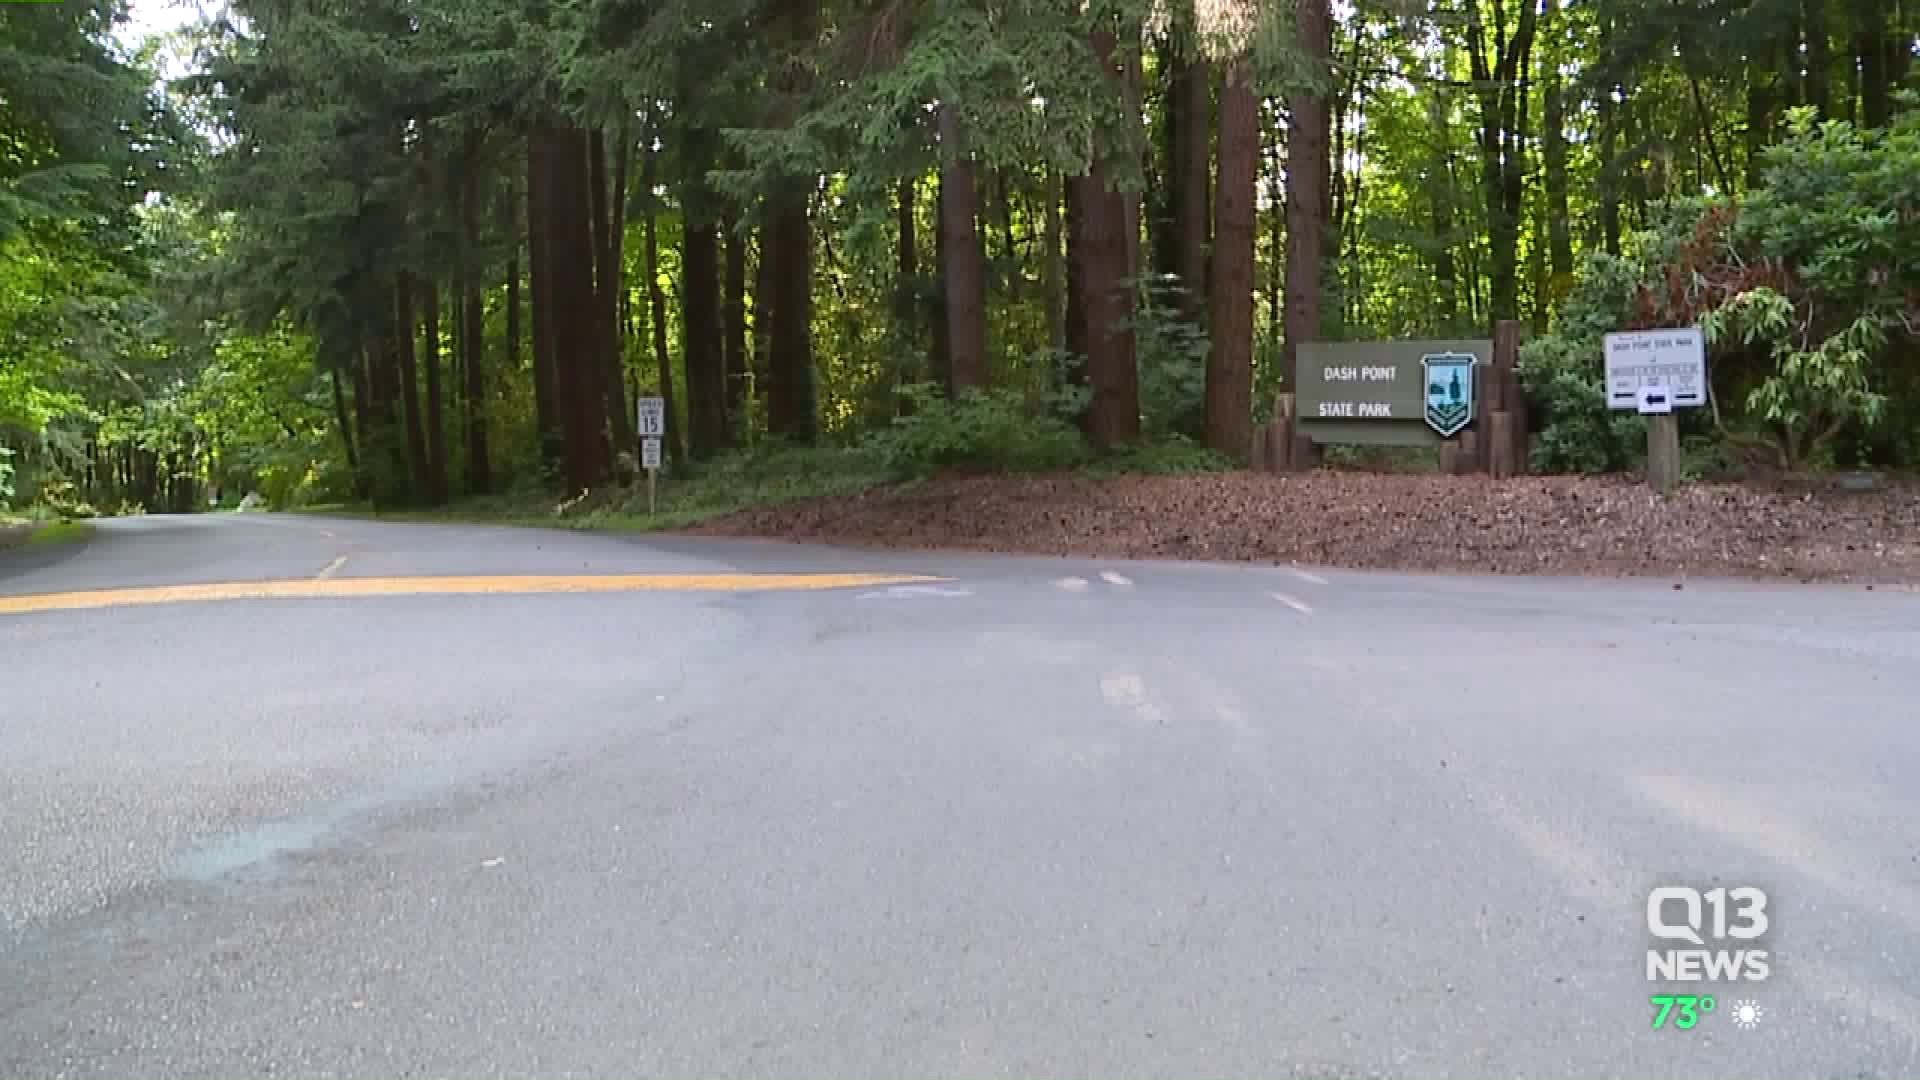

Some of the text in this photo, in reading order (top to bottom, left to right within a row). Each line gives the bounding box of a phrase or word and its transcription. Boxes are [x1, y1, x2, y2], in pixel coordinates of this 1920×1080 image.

[1324, 367, 1396, 381] DASH POINT
[1319, 402, 1392, 417] STATE PARK
[644, 416, 658, 432] 15
